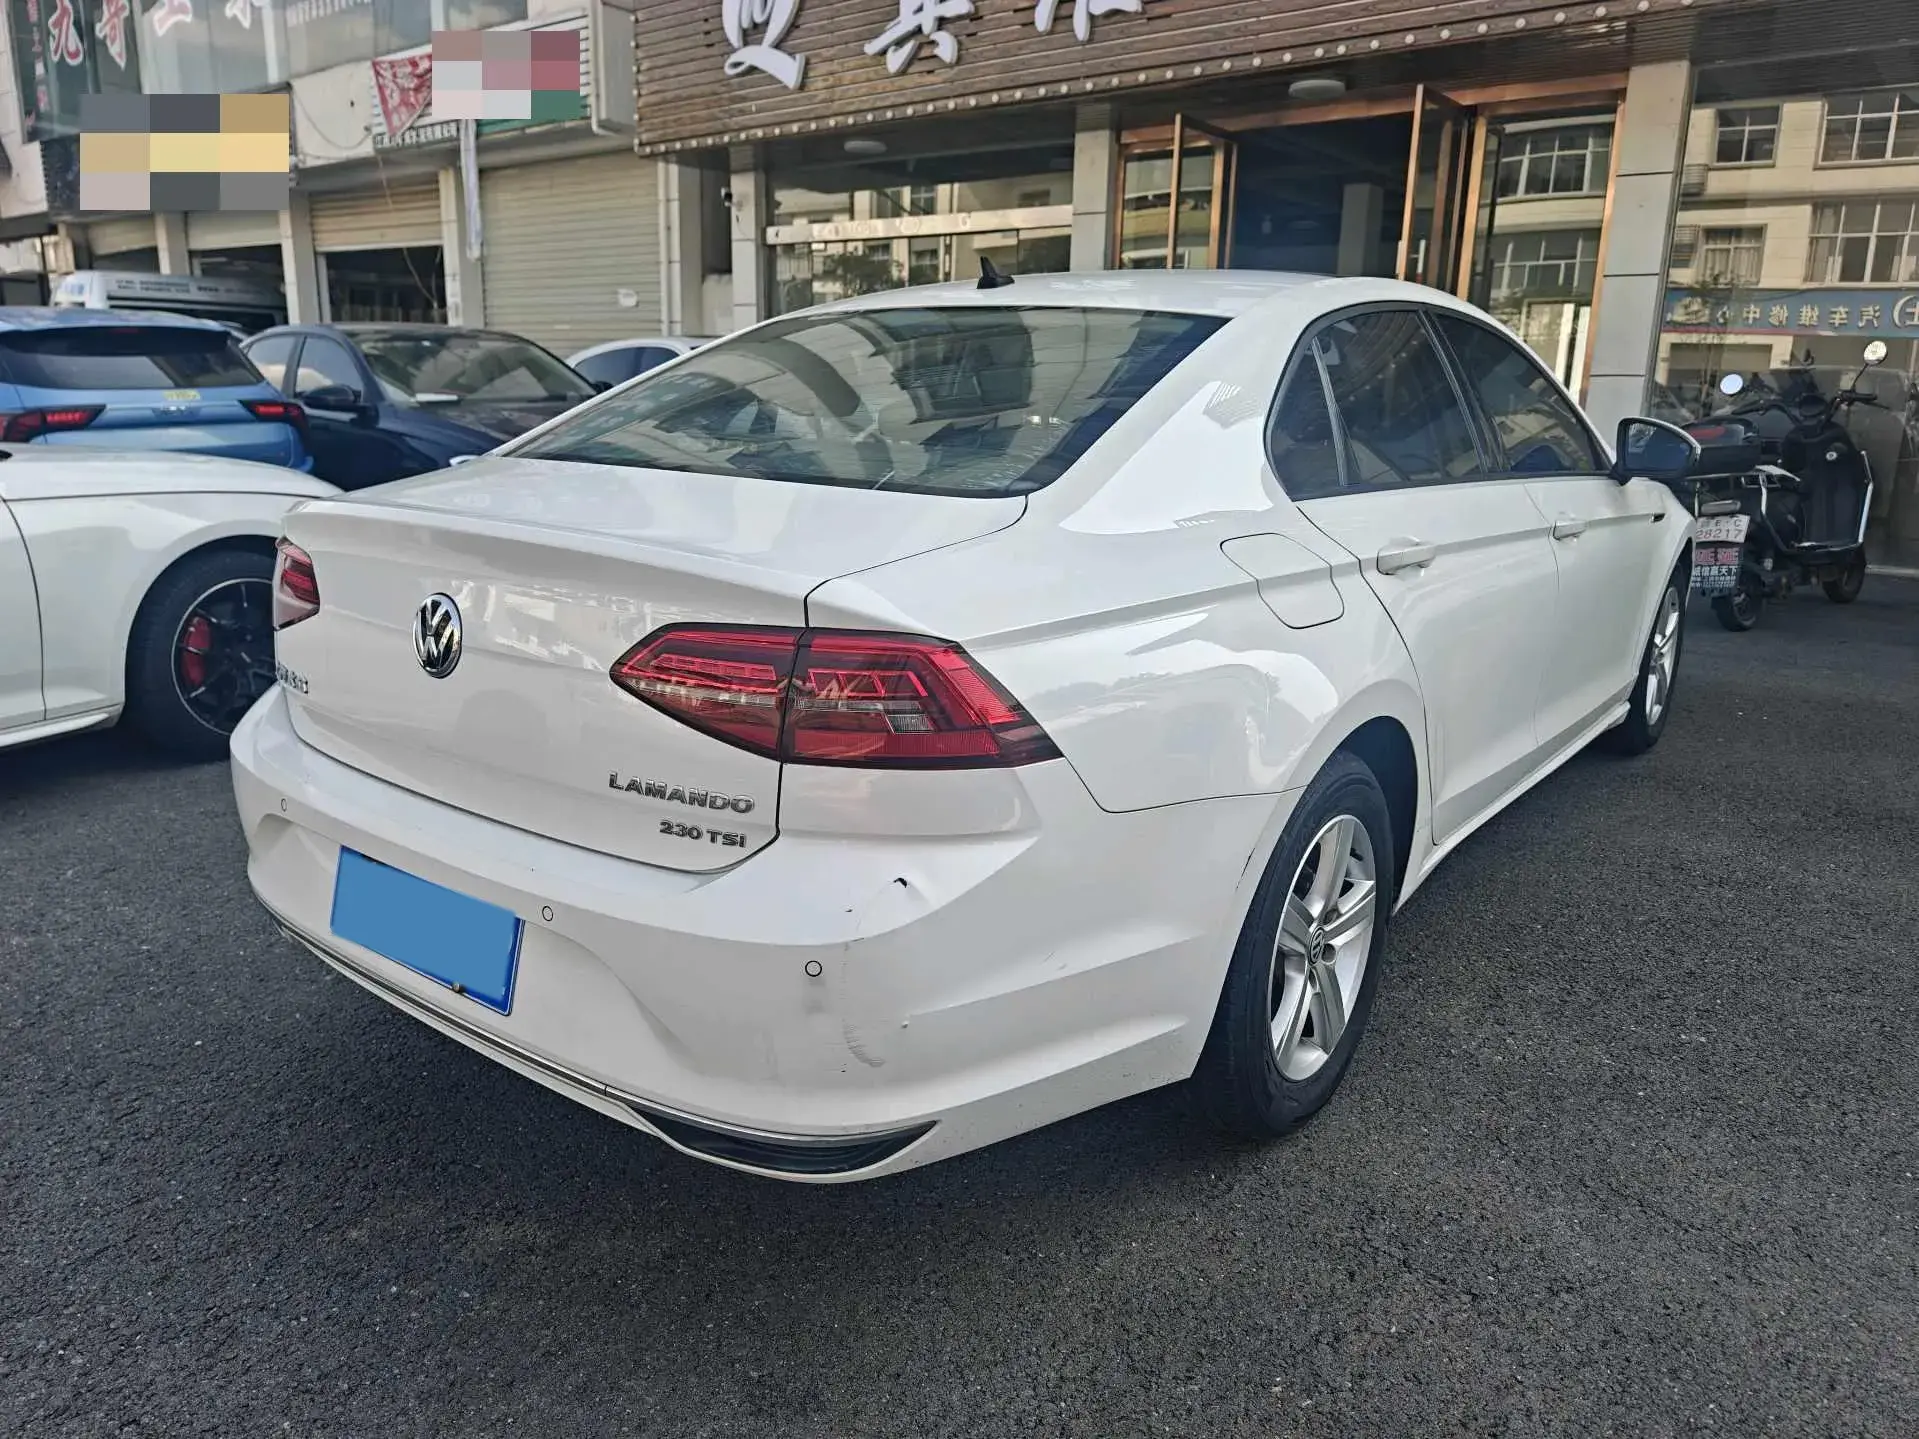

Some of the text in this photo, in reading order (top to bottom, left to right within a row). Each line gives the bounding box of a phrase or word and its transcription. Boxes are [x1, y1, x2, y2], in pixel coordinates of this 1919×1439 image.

[608, 771, 755, 813] LAMANDO
[659, 819, 747, 848] 230 TSI
